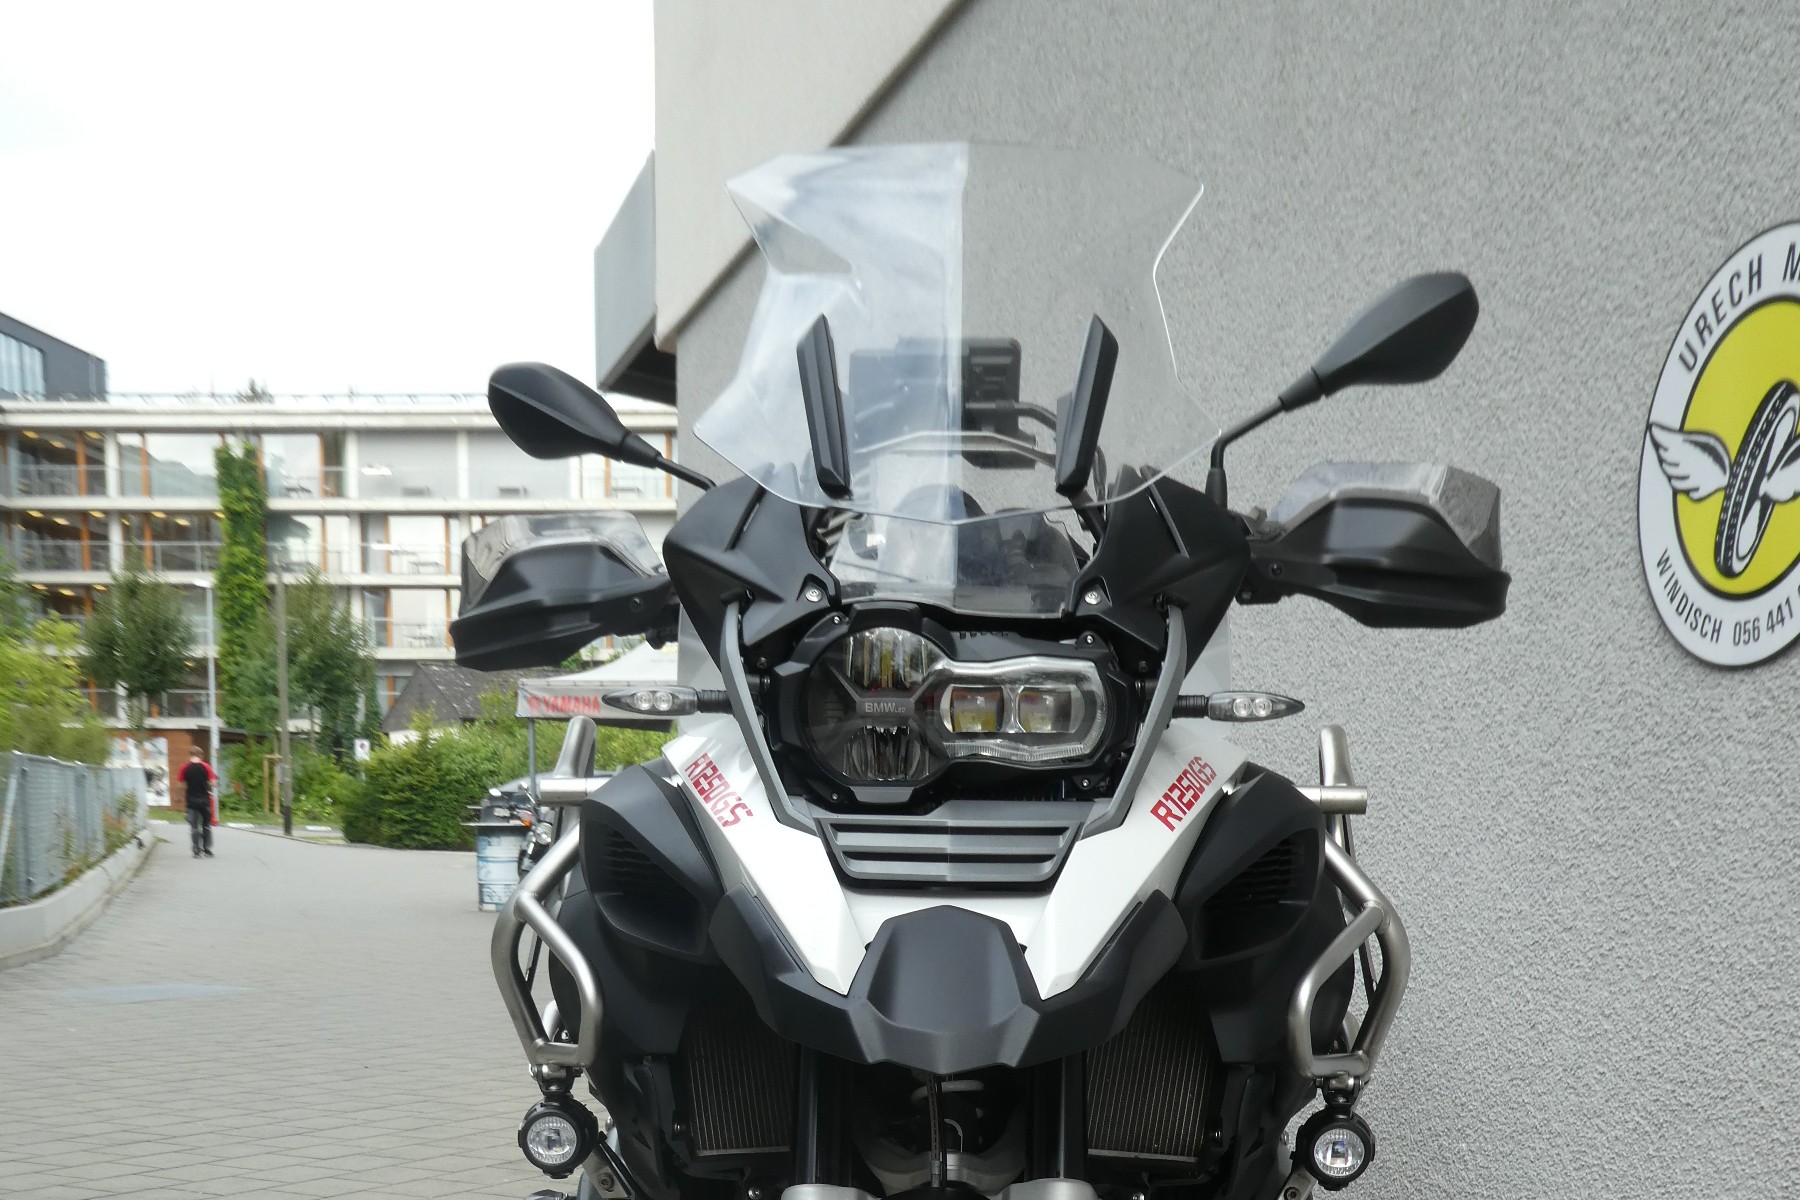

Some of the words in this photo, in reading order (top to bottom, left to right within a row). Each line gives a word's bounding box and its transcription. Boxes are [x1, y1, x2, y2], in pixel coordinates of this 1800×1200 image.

[1679, 253, 1763, 373] URECH
[1656, 547, 1722, 644] WINDISCH
[1732, 617, 1761, 646] 056
[1766, 596, 1793, 634] 441
[542, 695, 602, 714] YAMAHA
[865, 702, 896, 713] BMW
[684, 752, 754, 828] R1250GS
[1150, 756, 1217, 832] R1250GS
